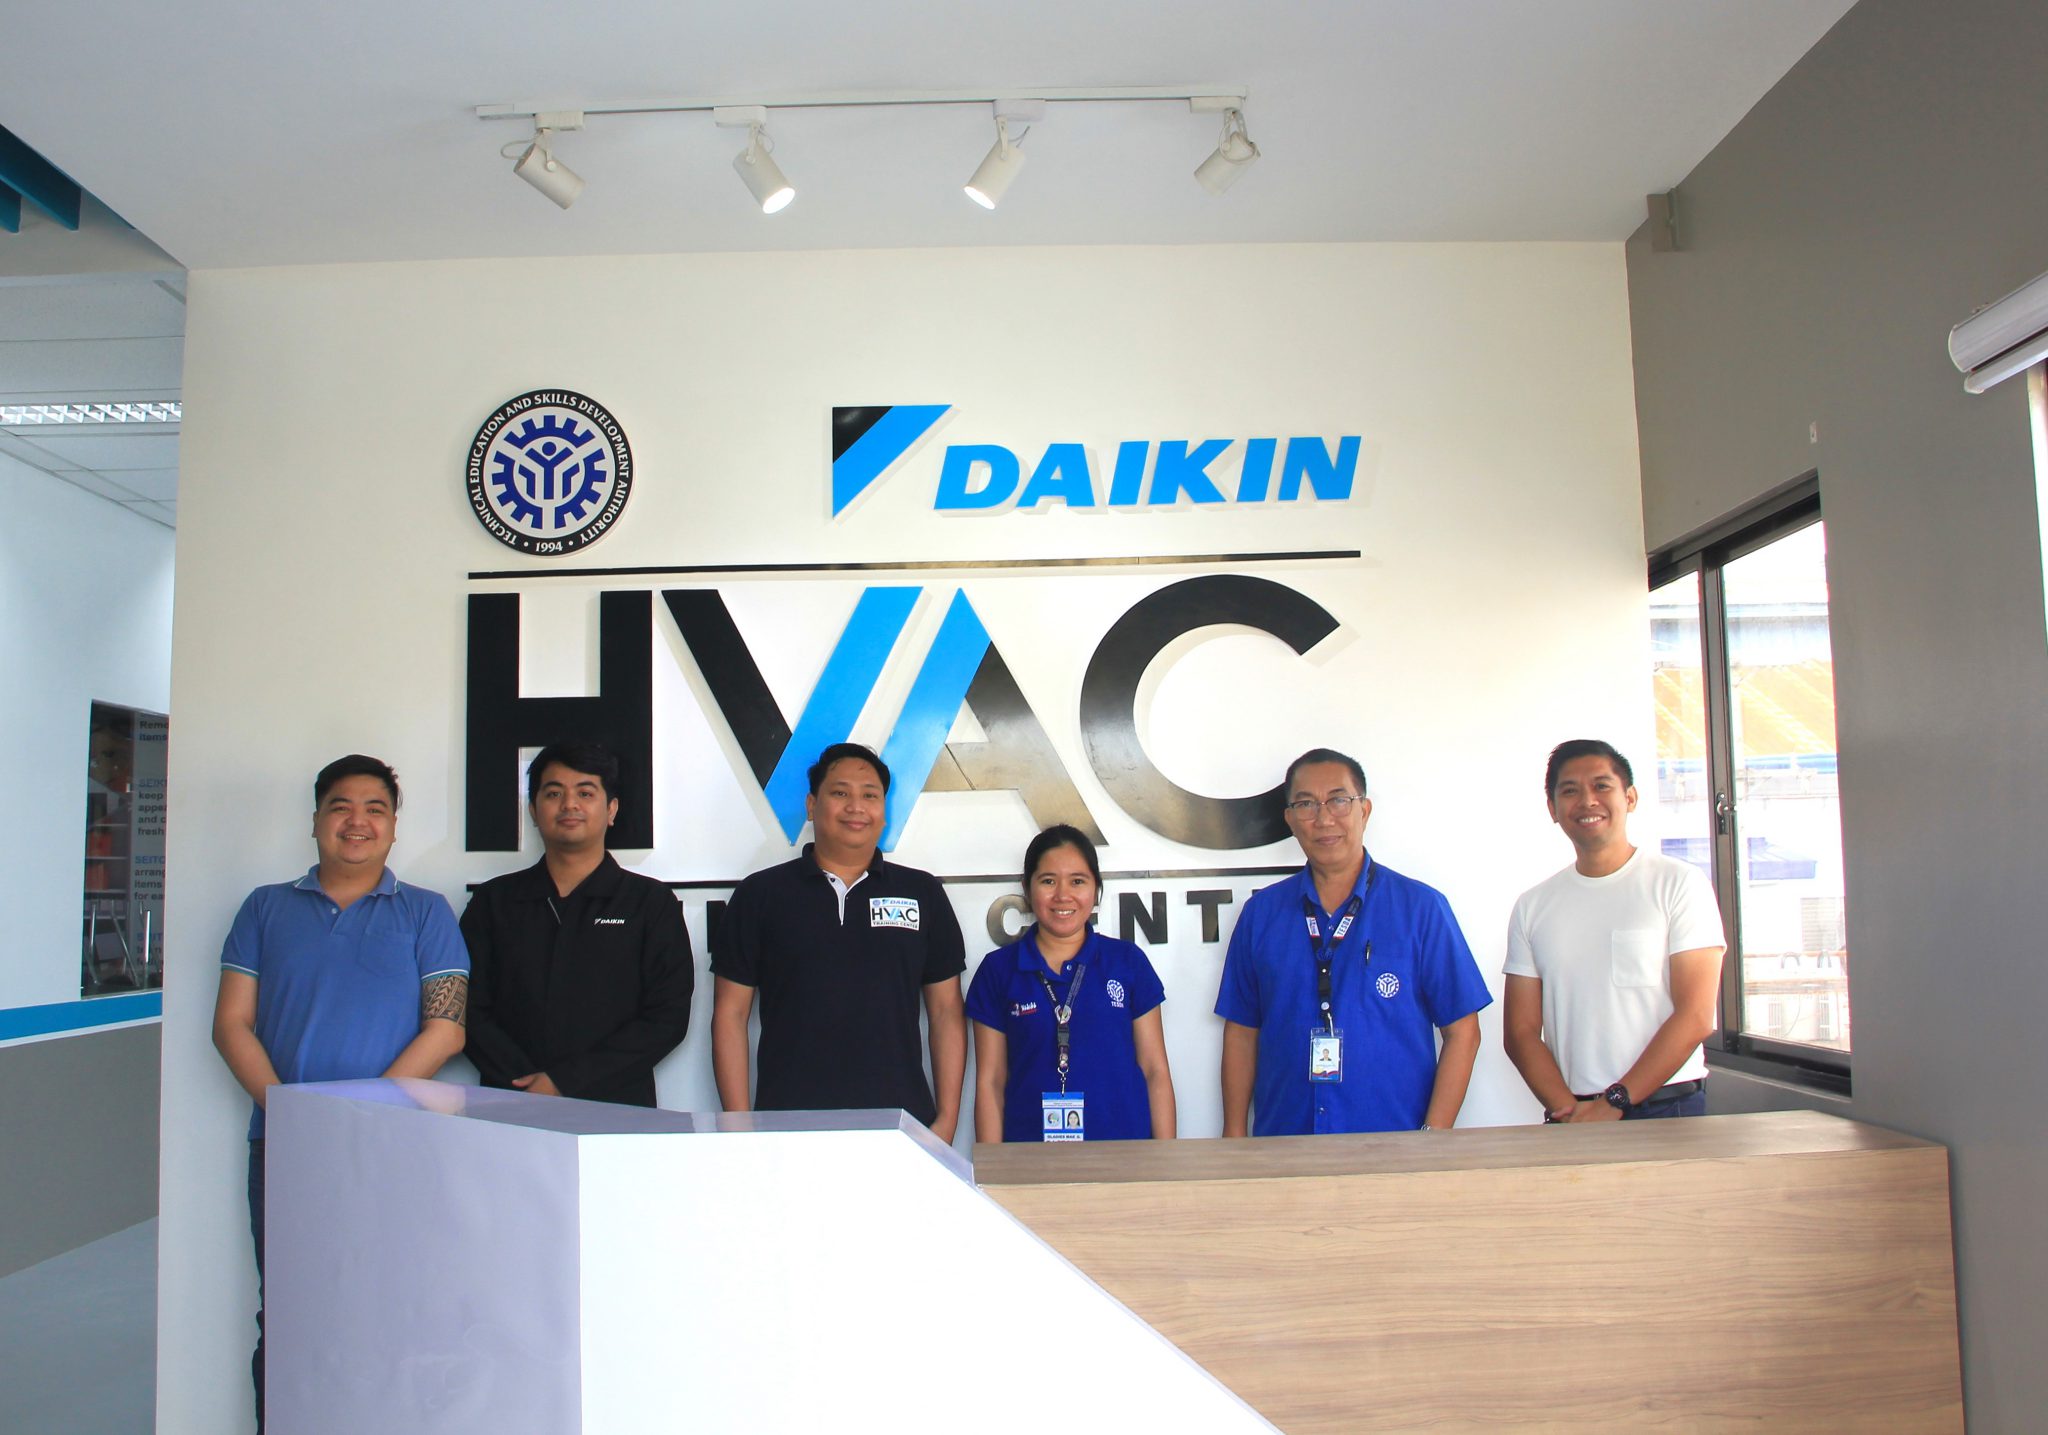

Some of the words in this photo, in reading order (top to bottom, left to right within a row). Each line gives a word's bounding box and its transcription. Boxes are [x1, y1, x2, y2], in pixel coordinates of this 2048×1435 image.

[505, 398, 532, 417] AND
[534, 393, 577, 407] SKILLS
[470, 412, 505, 483] EDUCATION
[578, 399, 630, 477] DEVELOPMENT
[933, 435, 1362, 511] DAIKIN
[472, 486, 517, 546] TECHNICAL
[580, 481, 628, 544] AUTHORITY
[535, 541, 563, 553] 1994
[466, 574, 1340, 852] HVAC
[139, 791, 163, 801] keep
[871, 907, 918, 923] HVAC
[1337, 917, 1352, 936] TESDA
